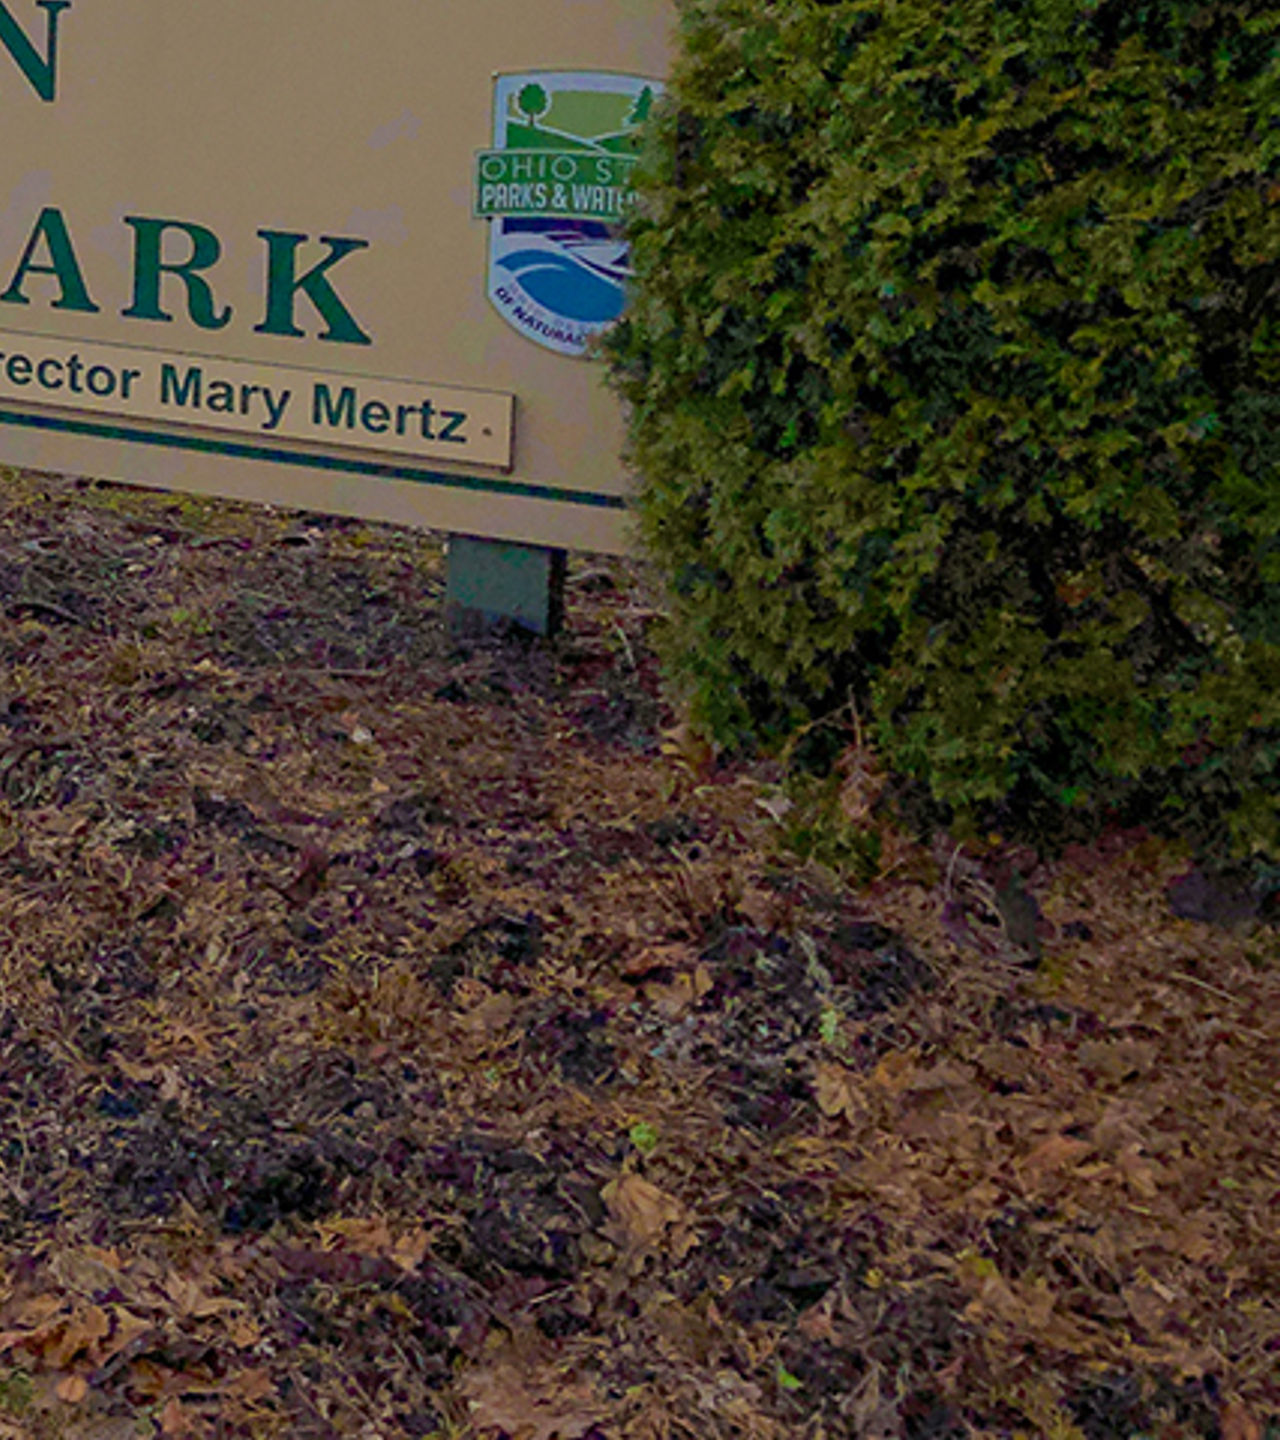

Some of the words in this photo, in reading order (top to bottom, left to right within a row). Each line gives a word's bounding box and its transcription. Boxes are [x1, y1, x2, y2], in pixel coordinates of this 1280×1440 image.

[482, 155, 577, 181] OHIO
[482, 183, 547, 209] PARKS
[551, 183, 568, 209] &
[159, 364, 291, 430] Mary
[313, 383, 467, 443] Mertz
